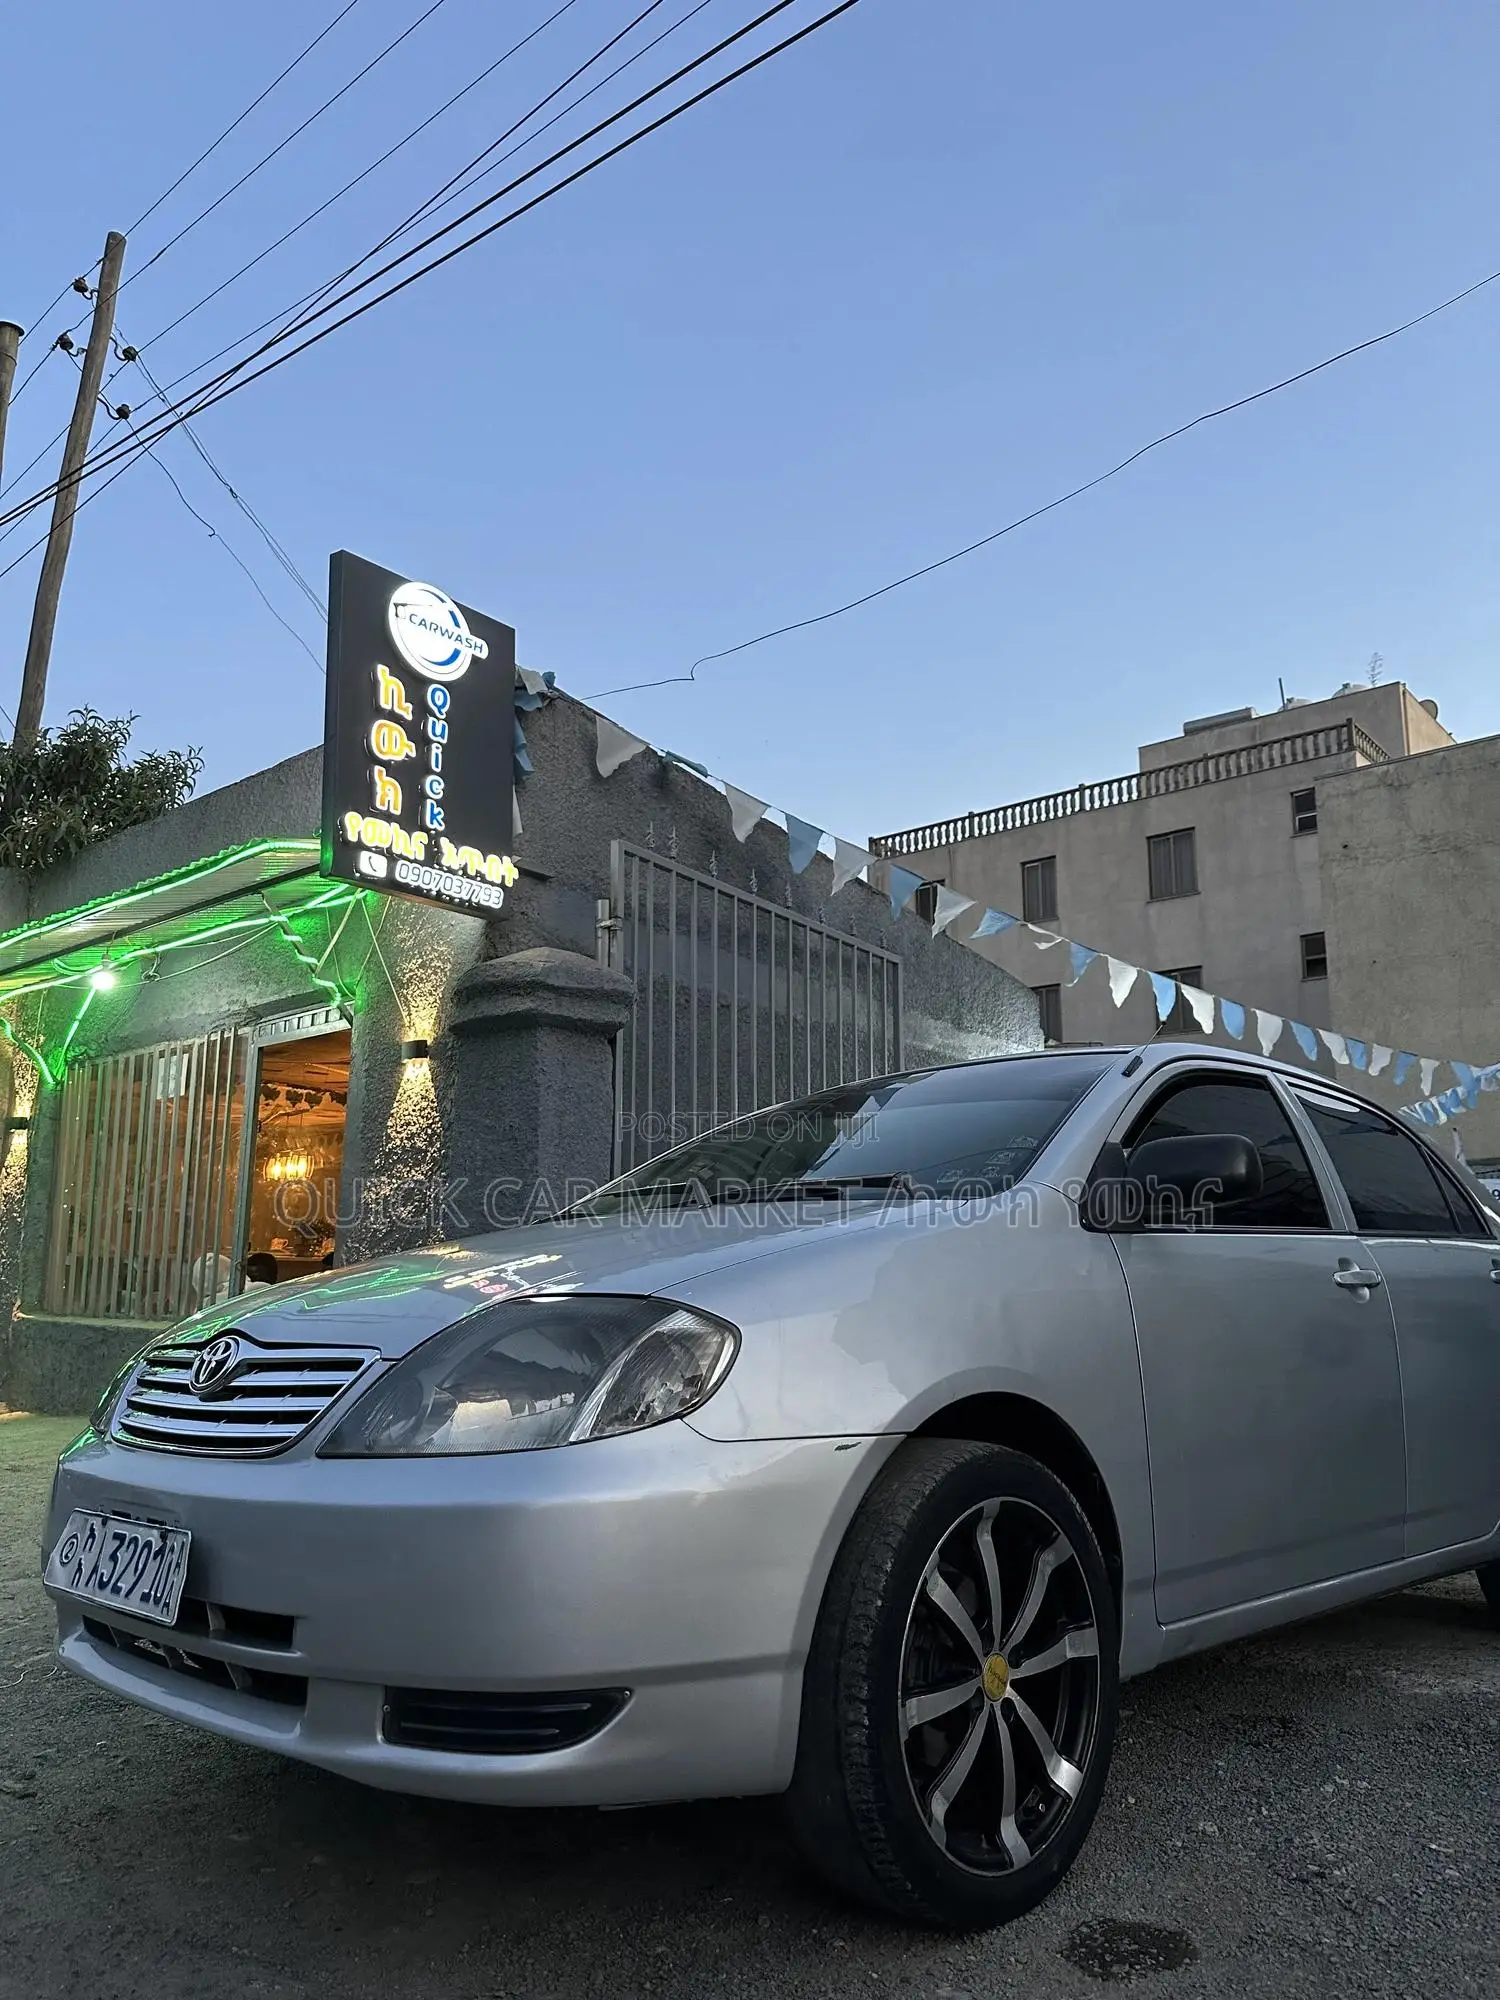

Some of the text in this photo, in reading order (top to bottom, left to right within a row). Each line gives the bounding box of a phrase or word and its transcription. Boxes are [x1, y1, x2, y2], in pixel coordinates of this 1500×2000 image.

[408, 612, 484, 655] CARWASH
[426, 684, 451, 831] Quick
[398, 861, 503, 907] 0907037793
